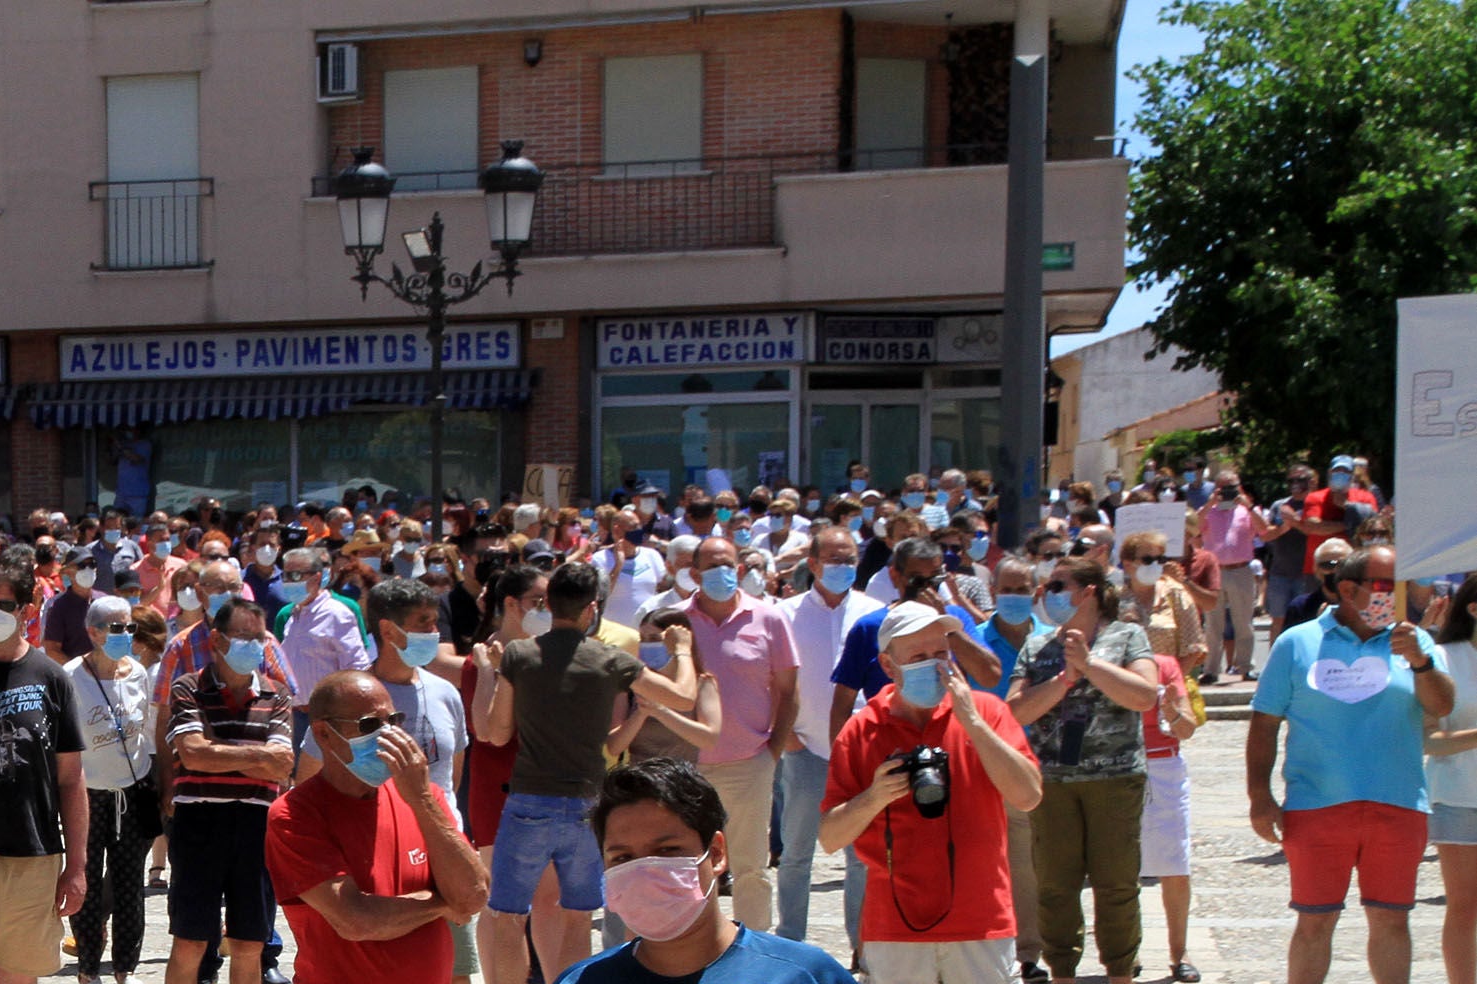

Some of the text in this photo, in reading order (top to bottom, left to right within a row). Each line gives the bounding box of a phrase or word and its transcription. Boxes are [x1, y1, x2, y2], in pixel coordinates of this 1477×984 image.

[603, 316, 799, 343] FONTANERIA Y
[70, 331, 510, 373] AZULEJOS PAVIMENTOS GRES
[609, 340, 796, 365] CALEFACCION
[829, 342, 932, 361] CONORSA
[17, 700, 43, 712] TOUR
